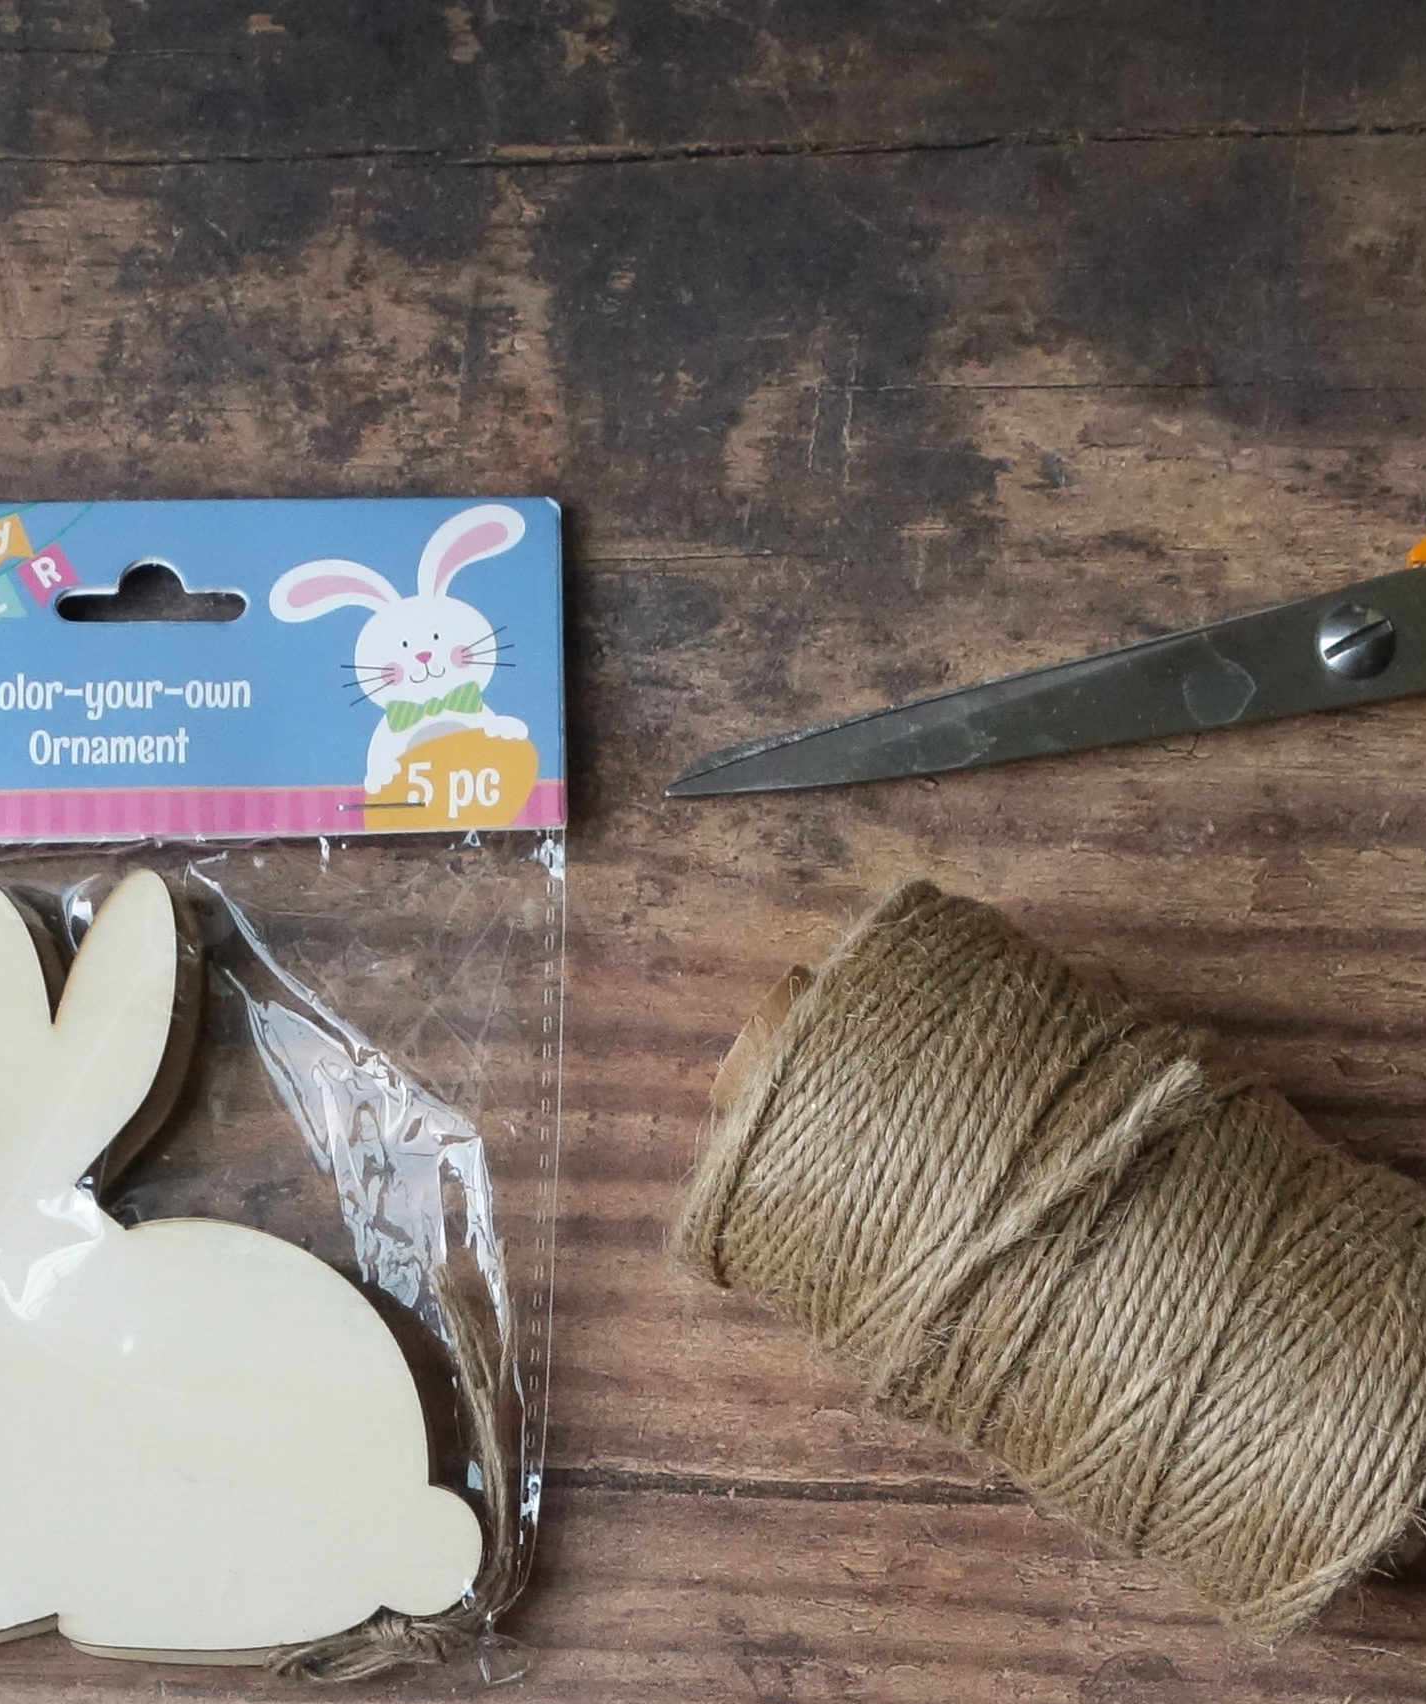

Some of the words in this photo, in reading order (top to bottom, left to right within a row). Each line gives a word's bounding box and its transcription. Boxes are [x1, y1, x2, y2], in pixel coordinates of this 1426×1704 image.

[29, 727, 190, 766] Ornament
[406, 761, 433, 808] 5
[448, 765, 501, 820] pc
